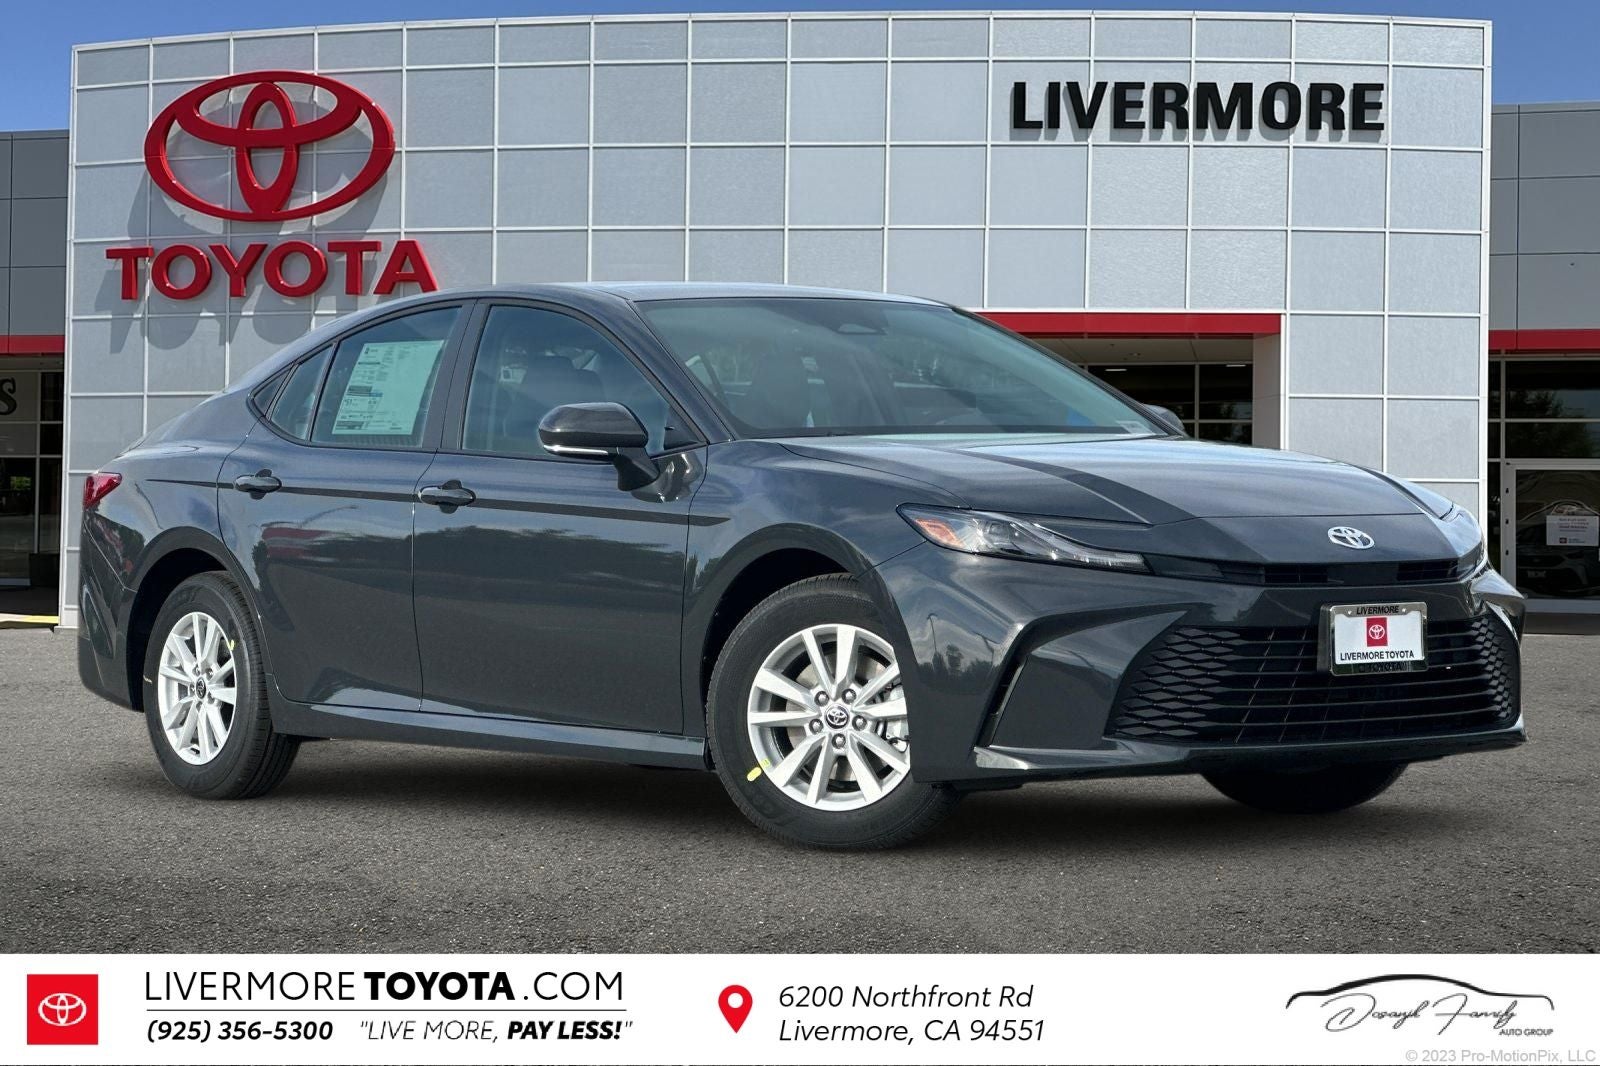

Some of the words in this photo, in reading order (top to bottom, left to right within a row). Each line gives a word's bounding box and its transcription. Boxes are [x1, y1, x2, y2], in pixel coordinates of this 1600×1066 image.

[1012, 81, 1385, 130] LIVERMORE
[105, 240, 438, 300] TOYOTA
[1356, 604, 1399, 615] LIVERMORE
[1340, 651, 1385, 661] LIVERMORE
[1386, 650, 1414, 659] TOYOTA
